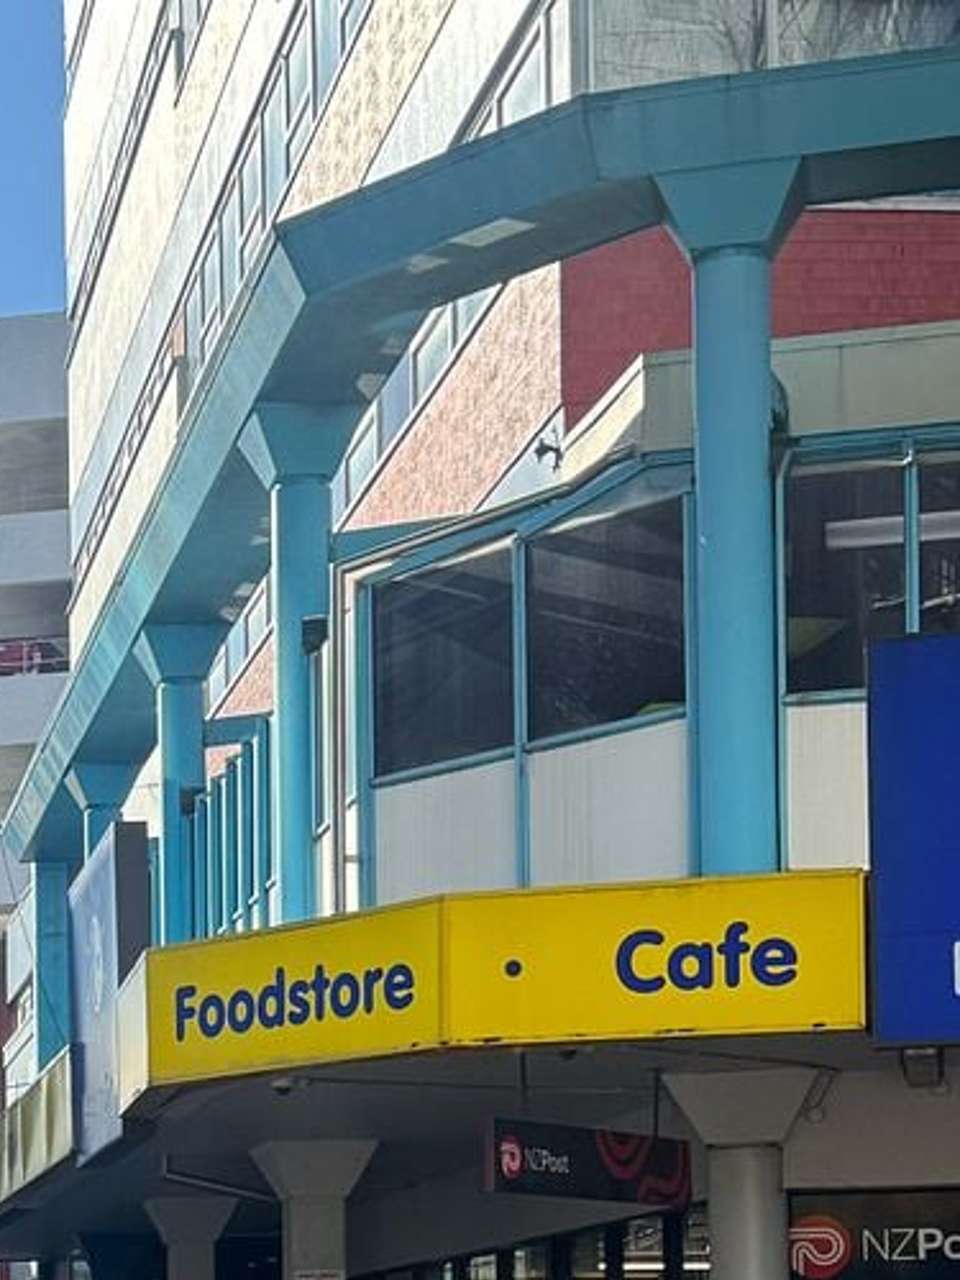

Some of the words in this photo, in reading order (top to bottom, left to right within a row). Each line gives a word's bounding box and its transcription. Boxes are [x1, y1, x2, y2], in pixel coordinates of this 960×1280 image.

[175, 963, 415, 1042] Foodstore
[616, 921, 797, 993] Cafe
[524, 1147, 571, 1174] NZPost
